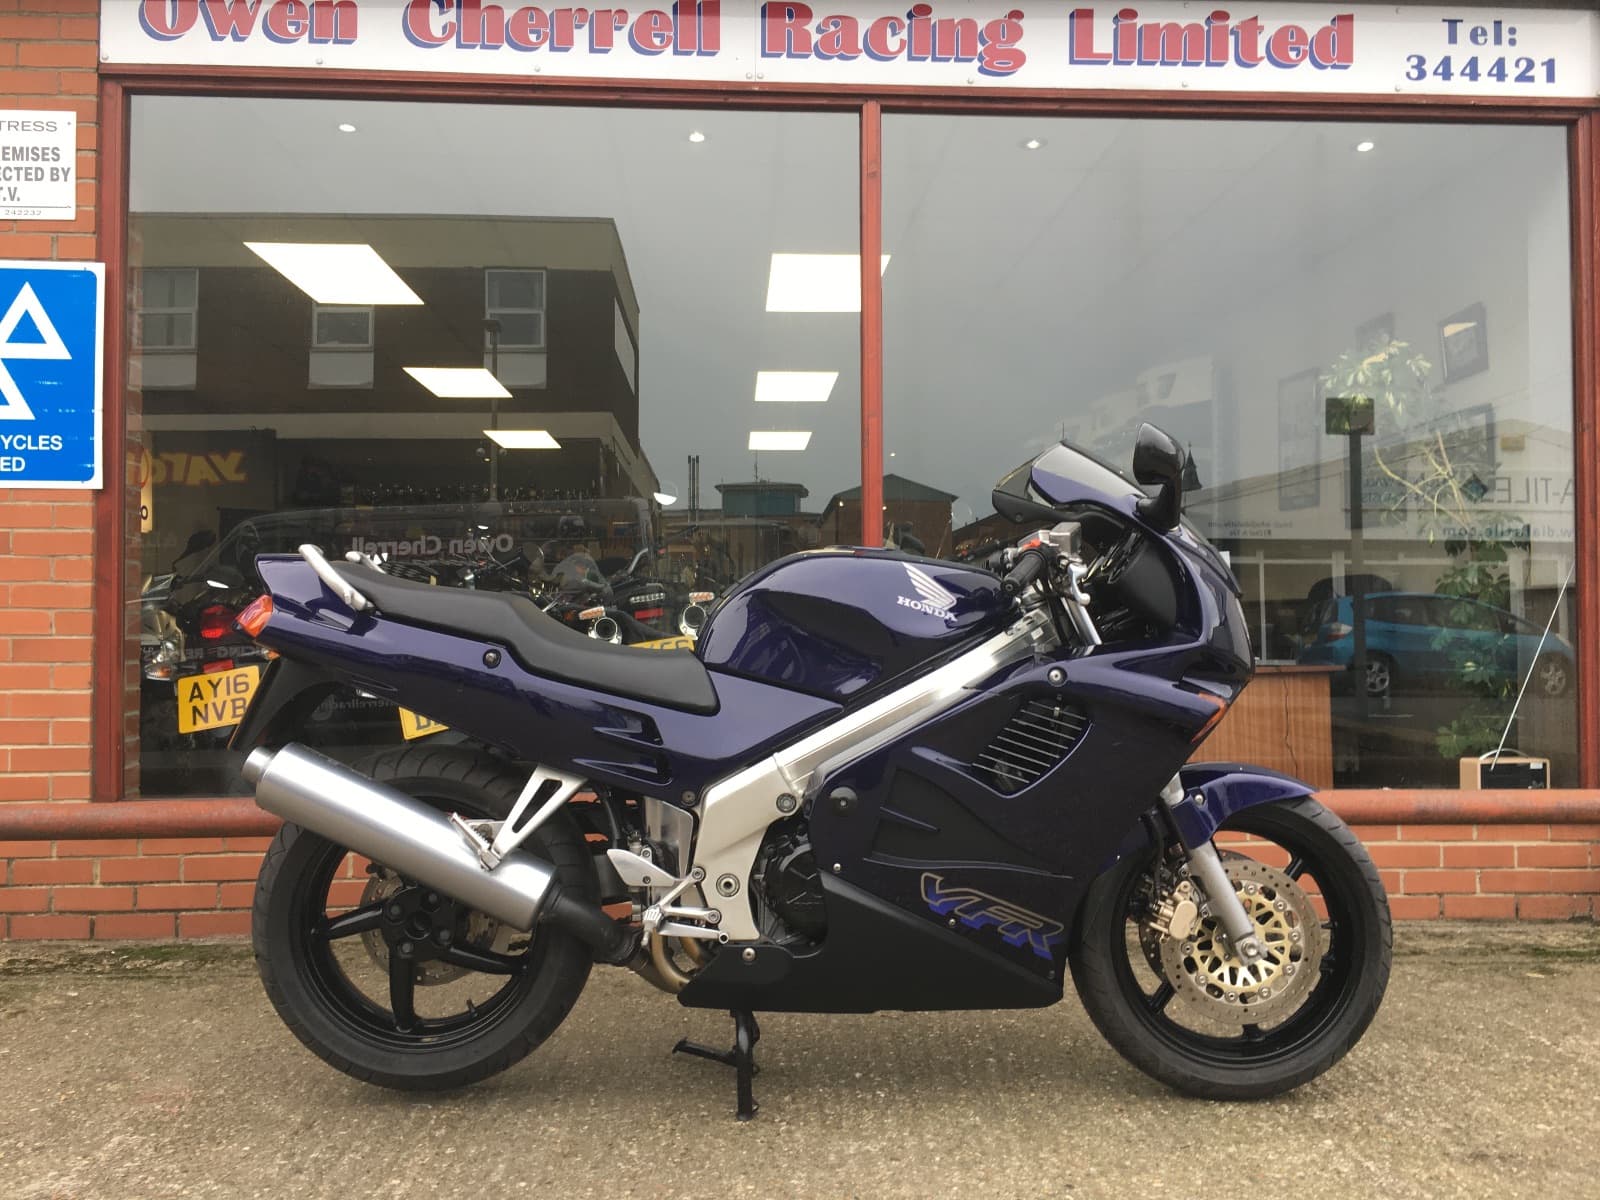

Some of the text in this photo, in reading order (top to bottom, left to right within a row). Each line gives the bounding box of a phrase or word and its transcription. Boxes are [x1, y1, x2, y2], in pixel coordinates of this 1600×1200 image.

[139, 0, 1354, 77] Owen Cherrell Racing Limited
[1442, 18, 1517, 47] Tel:
[1405, 54, 1556, 84] 344421
[0, 166, 71, 182] CTED BY
[0, 434, 63, 451] YCLES
[0, 456, 26, 472] ED
[896, 595, 958, 622] HONDA
[188, 672, 250, 703] AY16
[191, 696, 248, 727] NVB
[920, 872, 1065, 960] VFR
